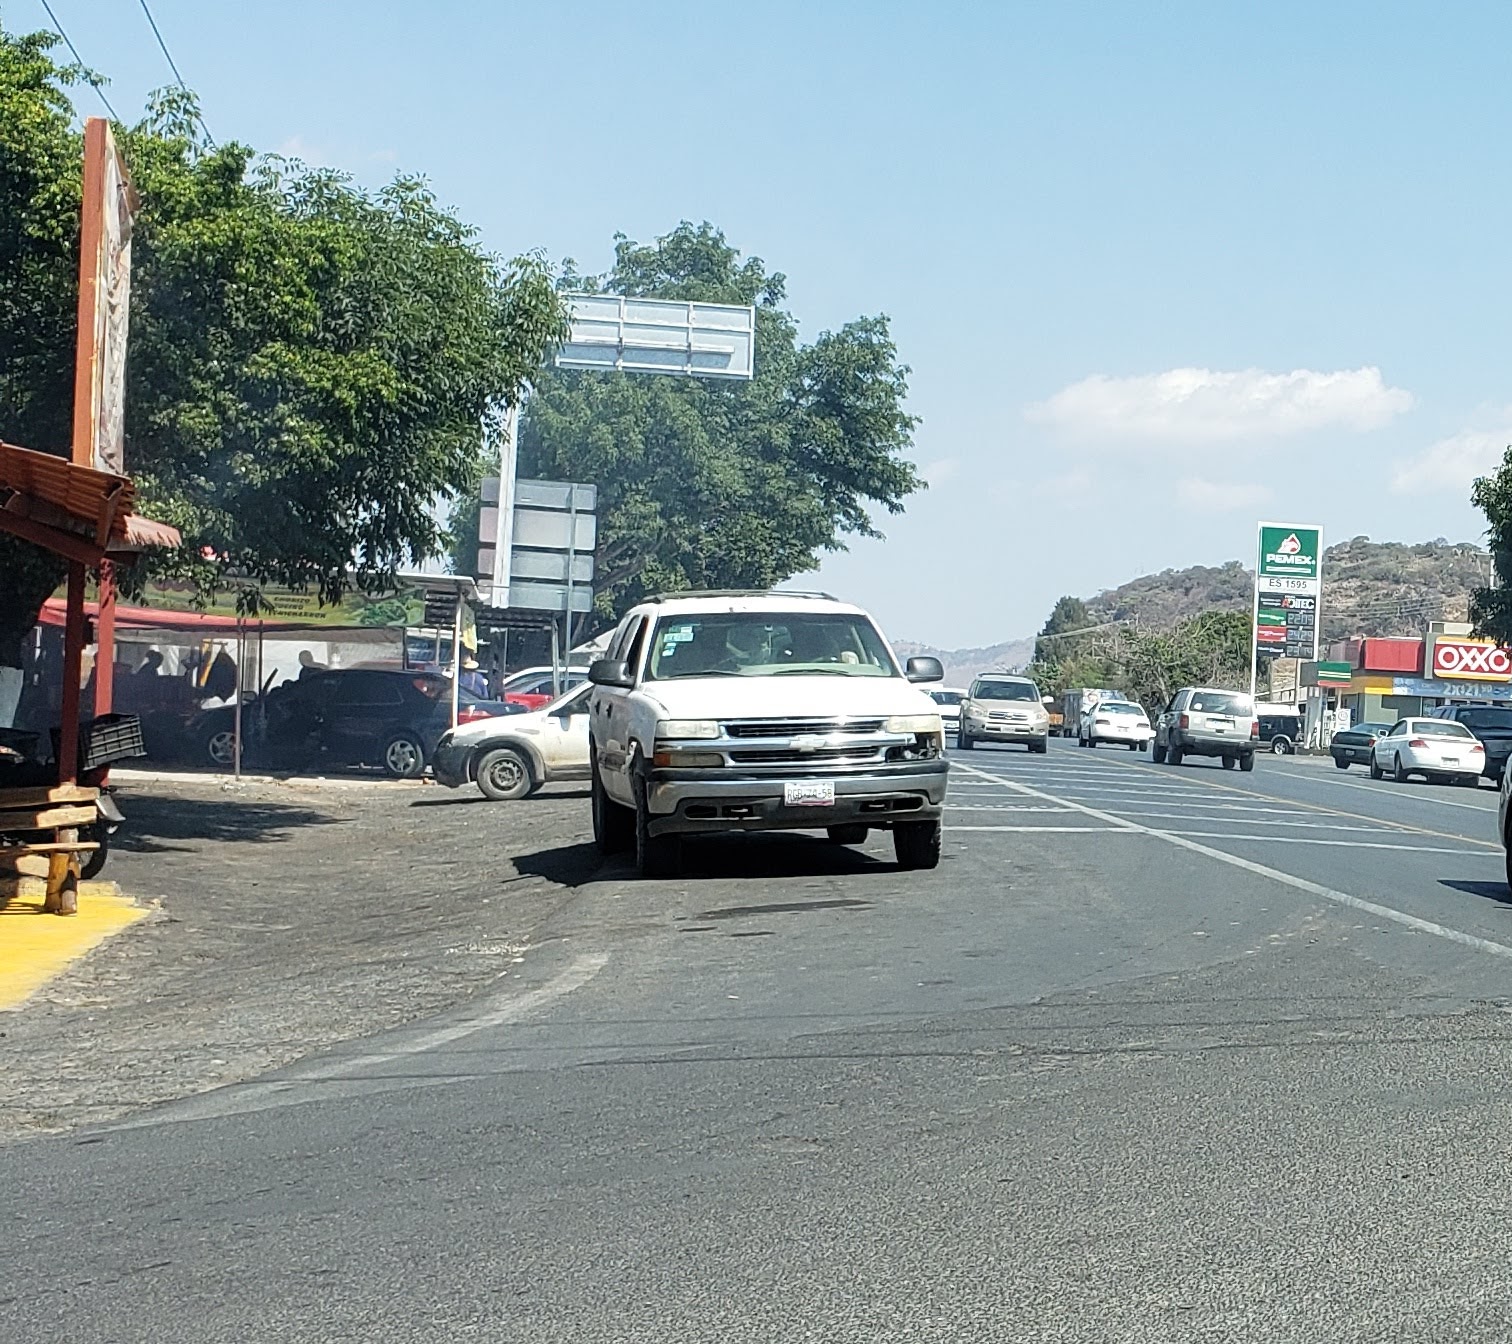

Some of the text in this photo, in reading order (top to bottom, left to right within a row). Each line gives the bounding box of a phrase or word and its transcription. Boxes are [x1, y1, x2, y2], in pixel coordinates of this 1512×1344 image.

[1265, 554, 1313, 565] PEMEX
[1269, 578, 1282, 588] ES
[1437, 646, 1510, 673] OXXO
